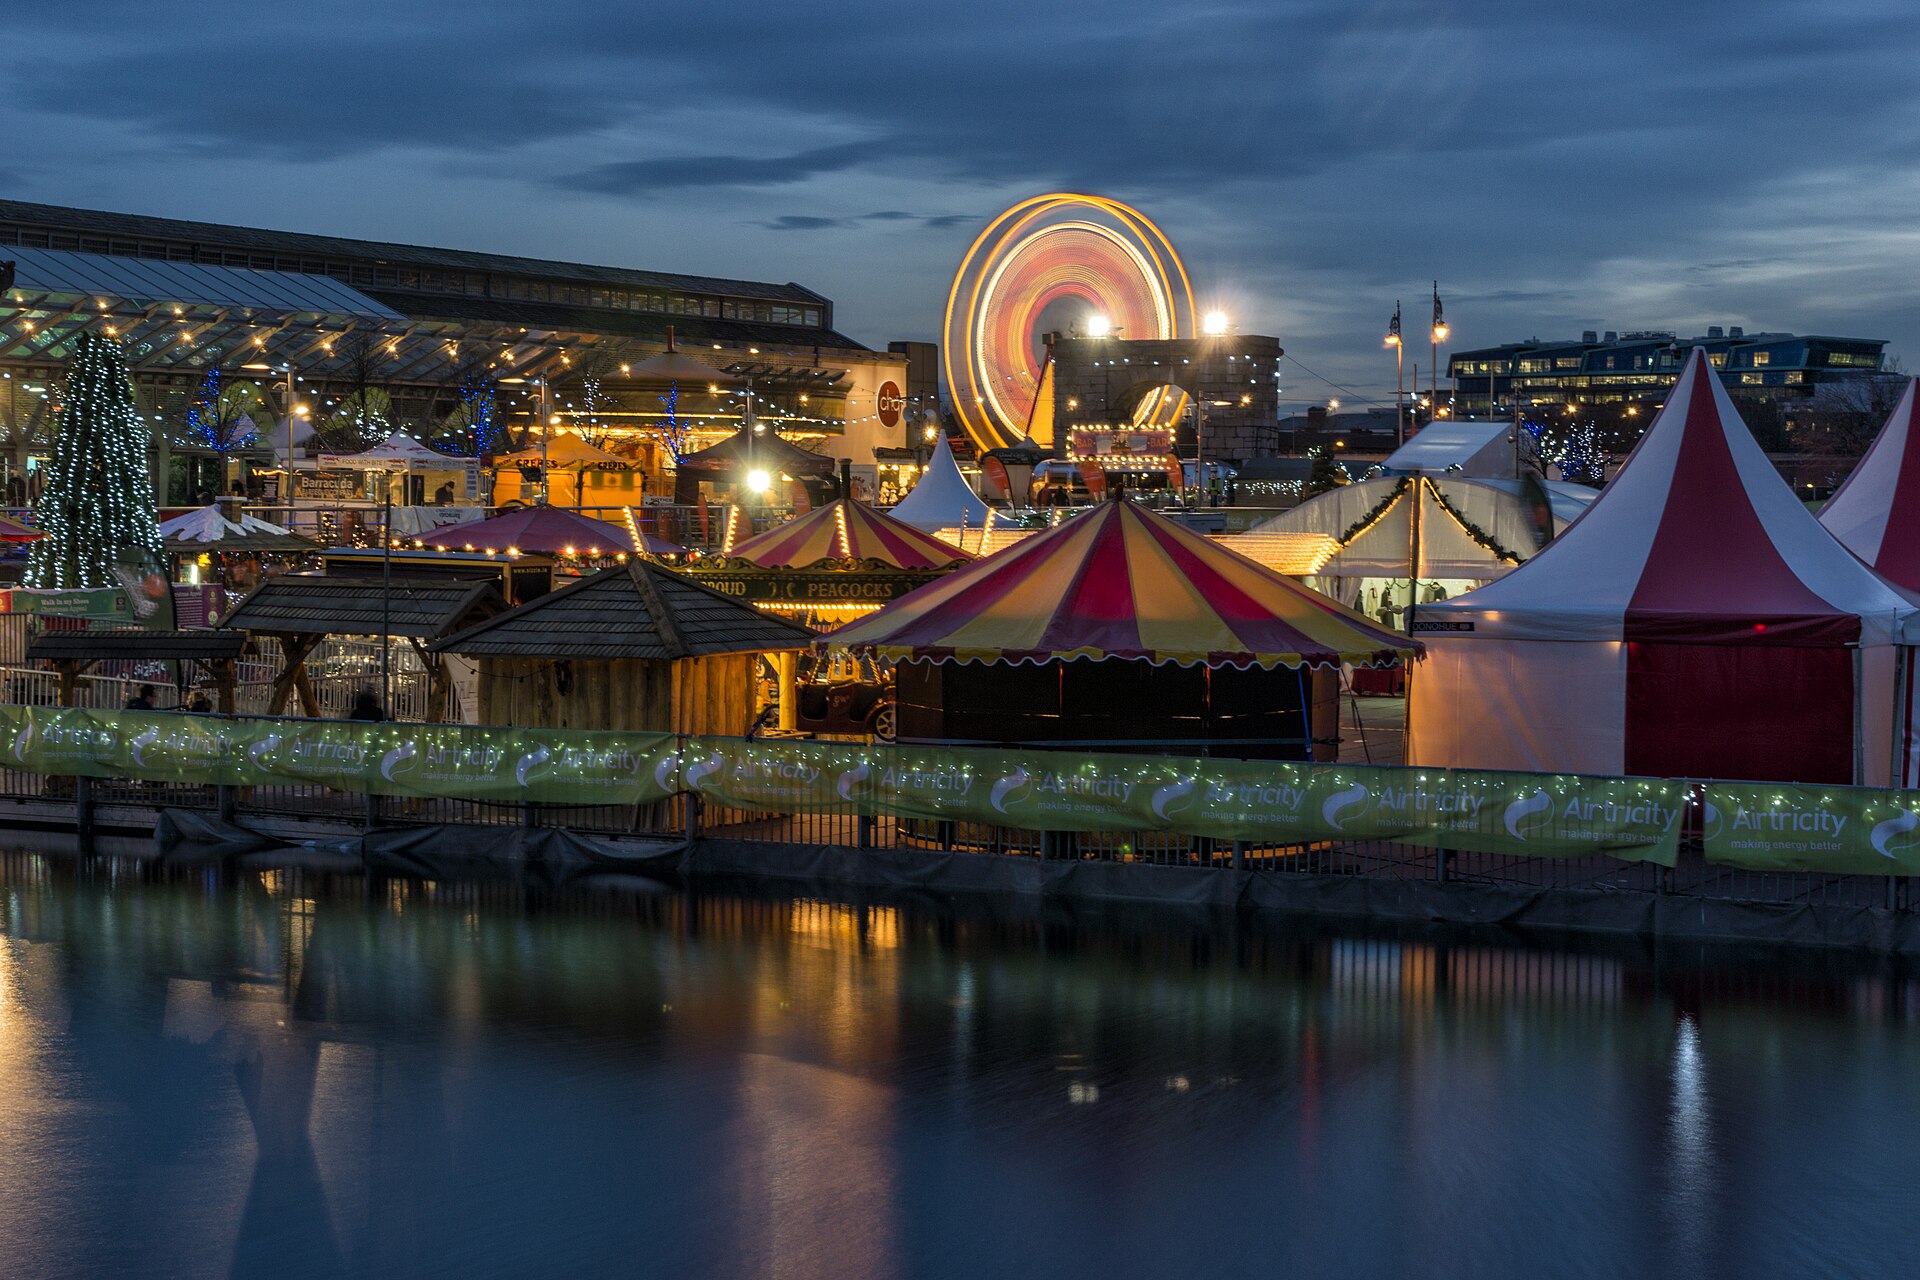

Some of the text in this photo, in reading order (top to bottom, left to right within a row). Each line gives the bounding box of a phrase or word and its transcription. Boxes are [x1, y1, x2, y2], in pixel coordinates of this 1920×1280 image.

[1076, 438, 1093, 448] BAR
[516, 458, 558, 469] CREPES
[598, 461, 627, 470] CREPES
[301, 477, 354, 489] Barracuda
[700, 581, 893, 597] OUD PEACOCKS
[289, 736, 368, 766] Airtricity
[424, 742, 502, 771] Airtricity
[559, 746, 641, 775] Airtricity
[880, 766, 974, 796] Airtricity
[1039, 769, 1137, 804] Airtricity
[943, 798, 969, 807] better
[1203, 781, 1306, 811] Airtricity
[1377, 785, 1485, 817] Airtricity
[1038, 801, 1072, 813] making
[1074, 803, 1105, 814] energy
[1563, 795, 1678, 833] Airtricity
[1201, 810, 1235, 822] making
[1270, 813, 1299, 823] better
[1377, 818, 1412, 830] making
[1731, 804, 1848, 838] Airtricity
[1560, 829, 1599, 842] making
[1731, 839, 1843, 853] making energy better
